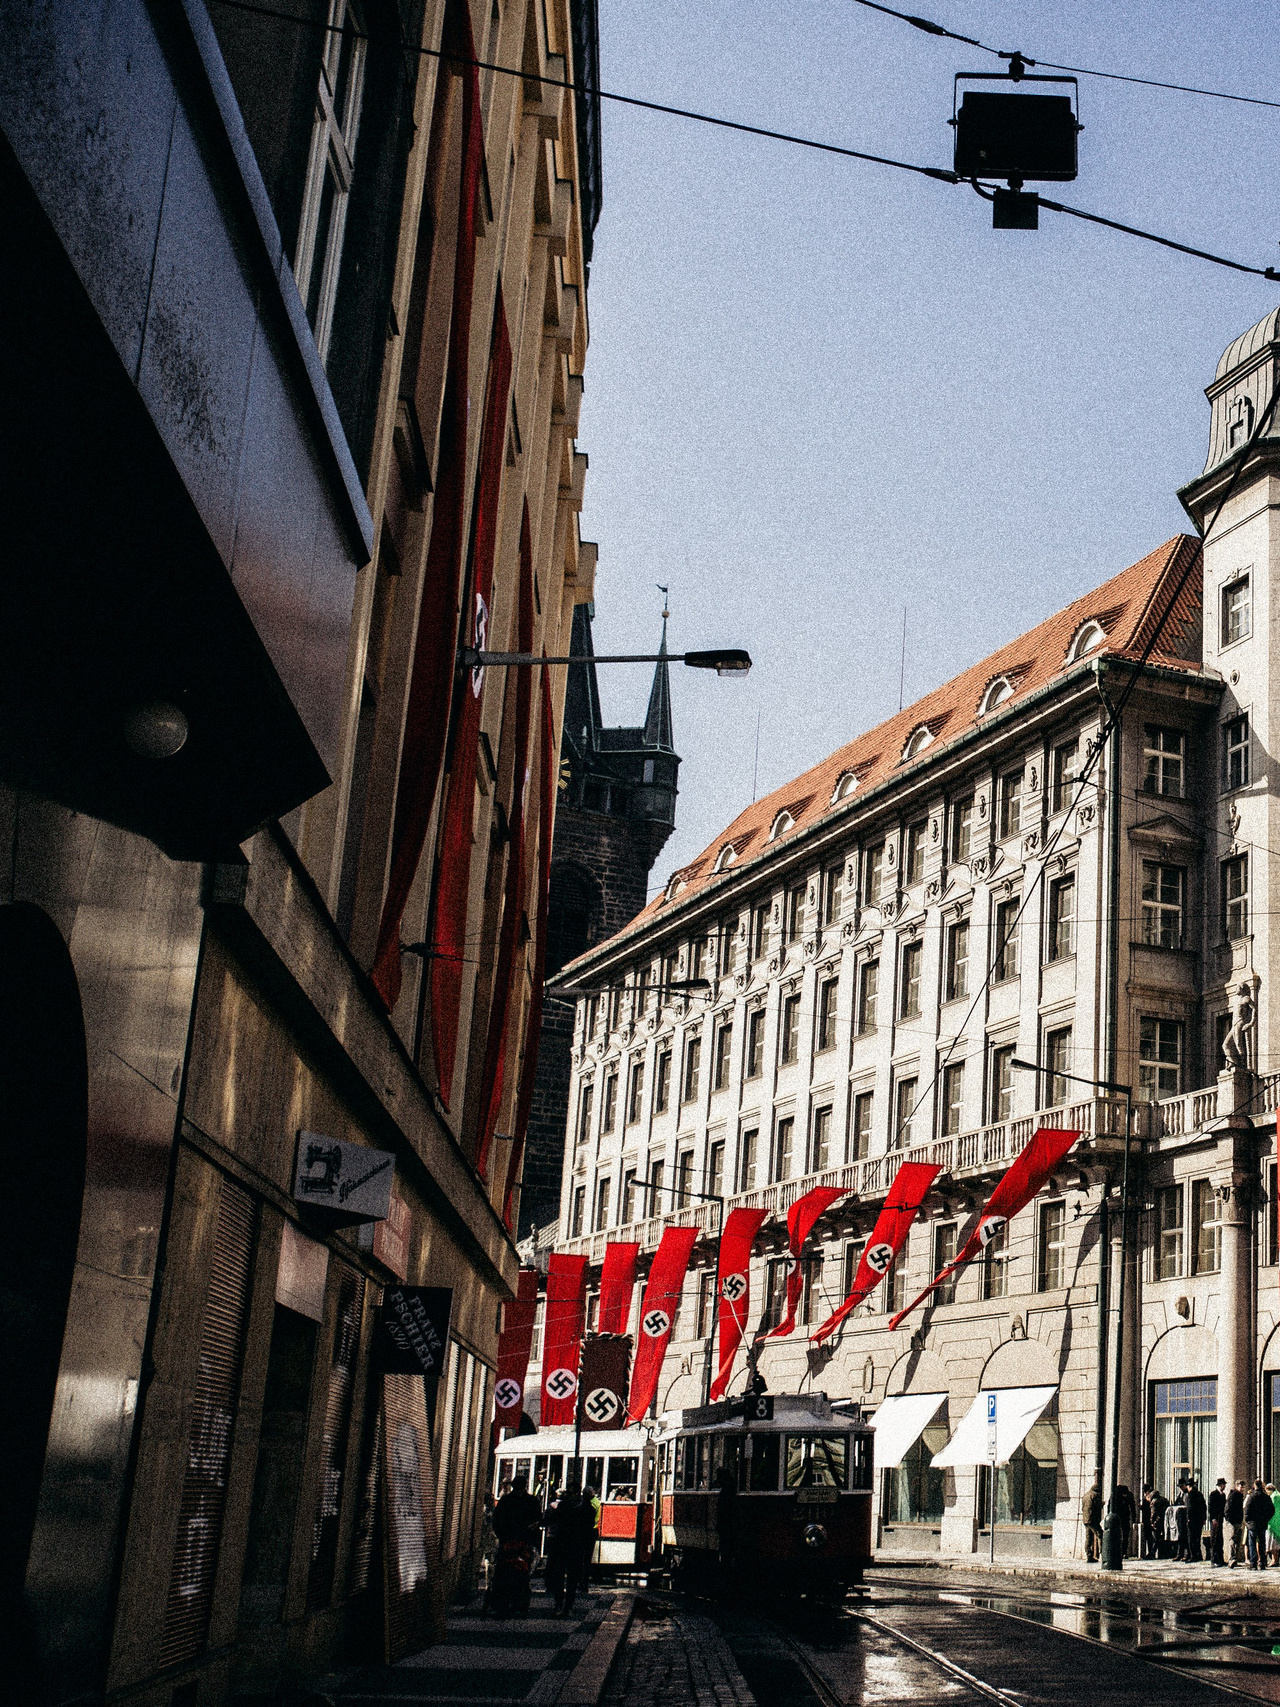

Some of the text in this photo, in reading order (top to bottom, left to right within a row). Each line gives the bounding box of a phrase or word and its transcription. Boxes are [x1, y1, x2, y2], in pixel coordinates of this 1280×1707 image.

[384, 1321, 412, 1350] 1890
[389, 1289, 435, 1370] PSCHIER
[408, 1295, 442, 1351] FRANZ
[756, 1397, 768, 1418] 8
[989, 1396, 995, 1416] P
